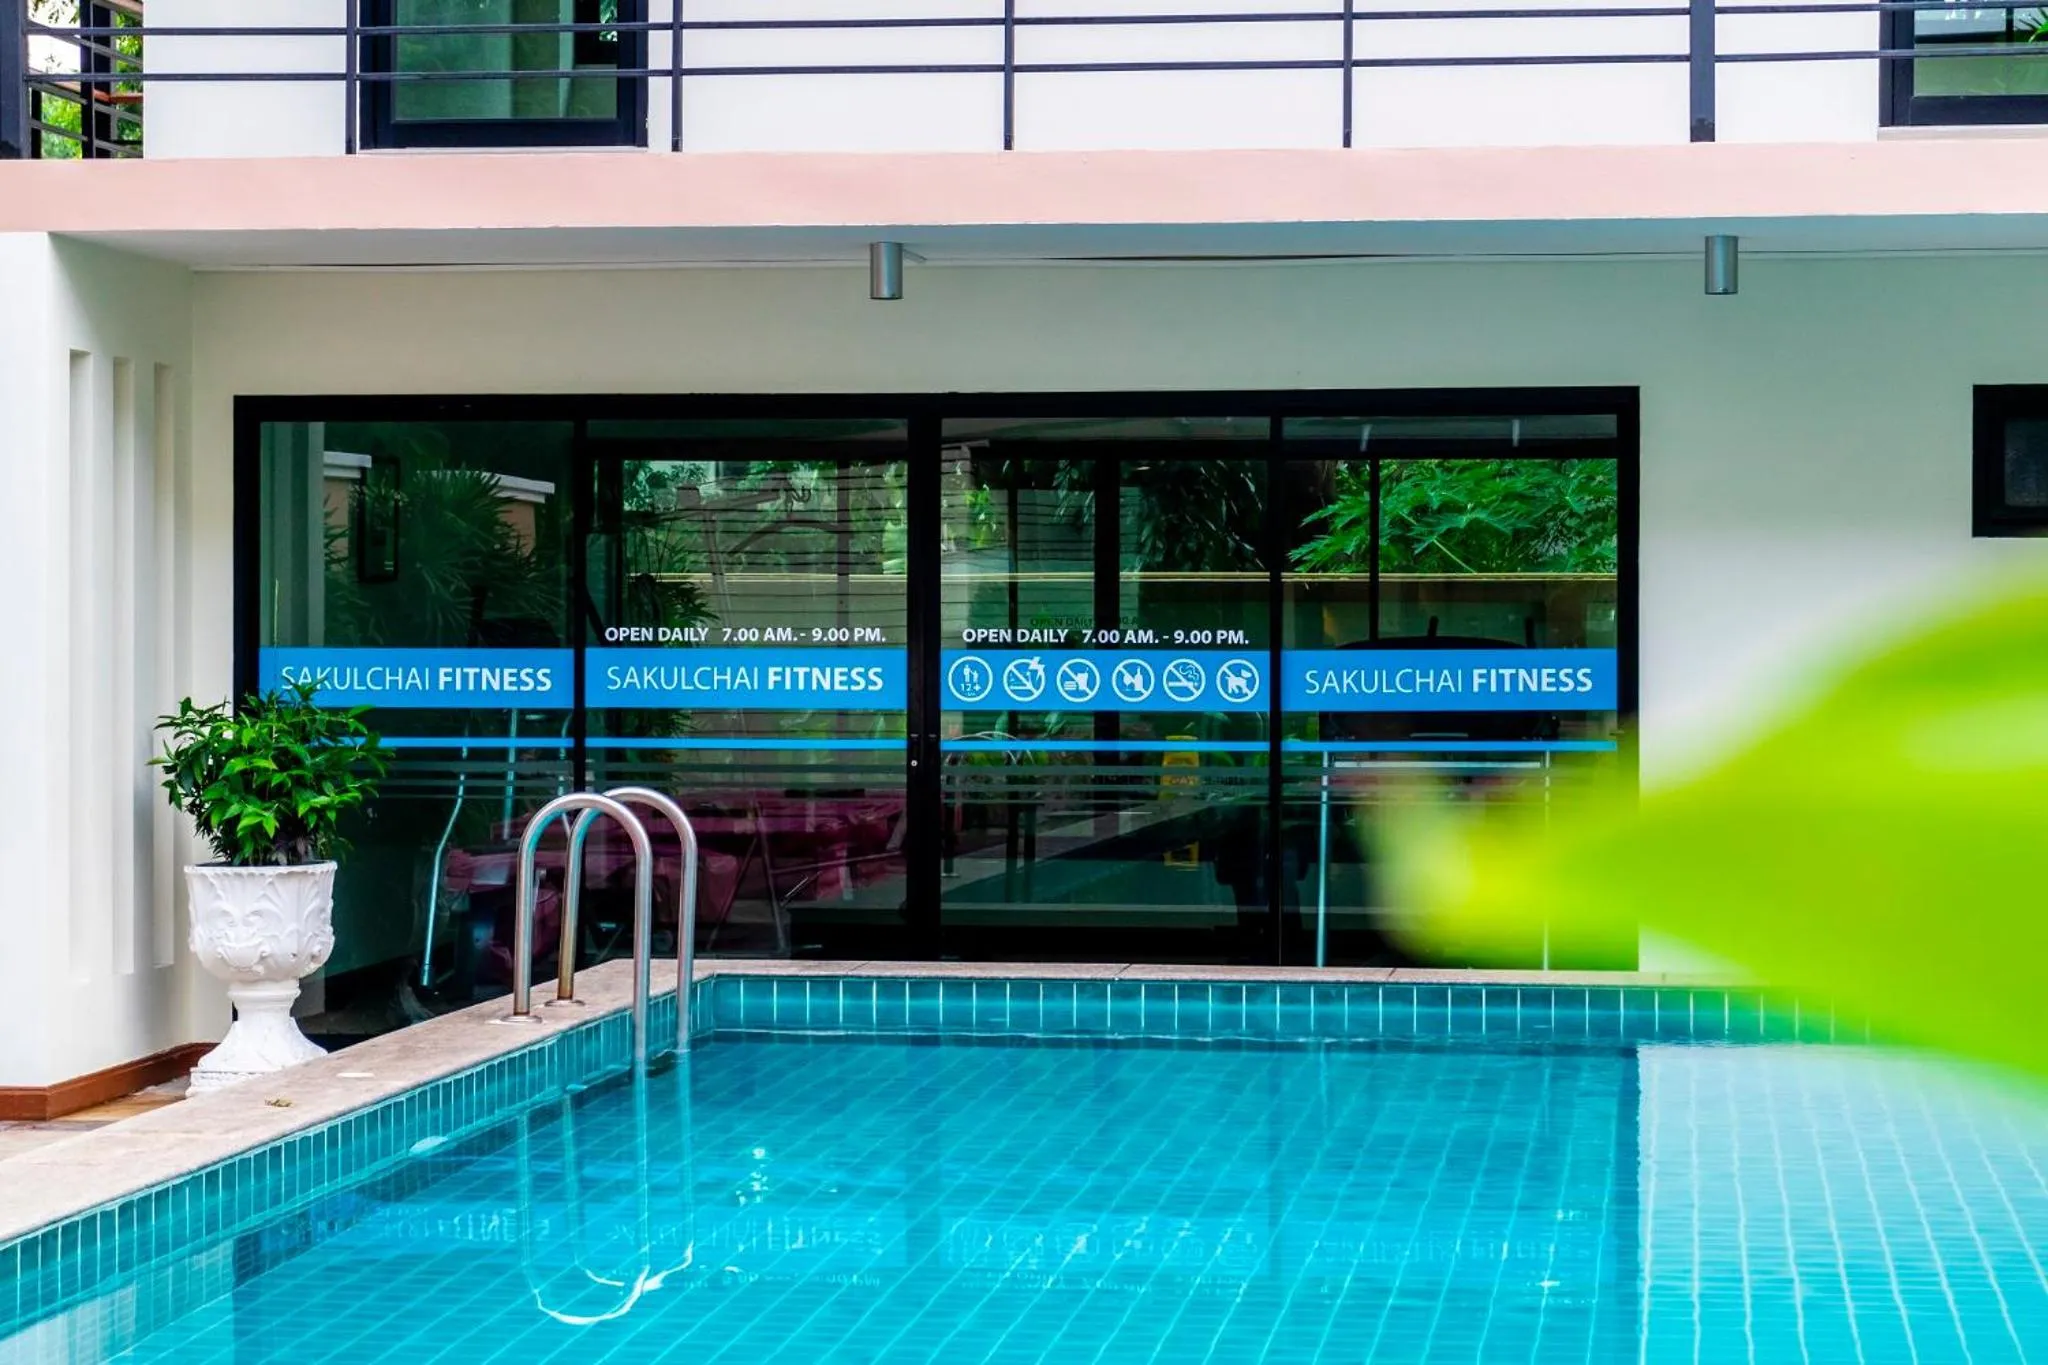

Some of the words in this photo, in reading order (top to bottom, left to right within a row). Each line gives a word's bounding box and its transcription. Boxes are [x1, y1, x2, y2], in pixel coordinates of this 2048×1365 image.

[604, 627, 653, 642] OPEN
[658, 627, 709, 642] DAILY
[722, 627, 759, 642] 7.00
[811, 627, 850, 642] 9.00
[853, 627, 886, 642] PM.
[962, 628, 1012, 643] OPEN
[1016, 629, 1068, 643] DAILY
[1082, 630, 1120, 644] 7.00
[1124, 630, 1159, 644] AM.
[1174, 630, 1212, 645] 9.00
[1216, 630, 1249, 645] PM.
[281, 666, 429, 690] SAKULCHAI
[438, 667, 552, 692] FITNESS
[607, 666, 758, 690] SAKULCHAI
[767, 667, 884, 691] FITNESS
[1304, 668, 1462, 694] SAKULCHAI
[1472, 668, 1593, 693] FITNESS
